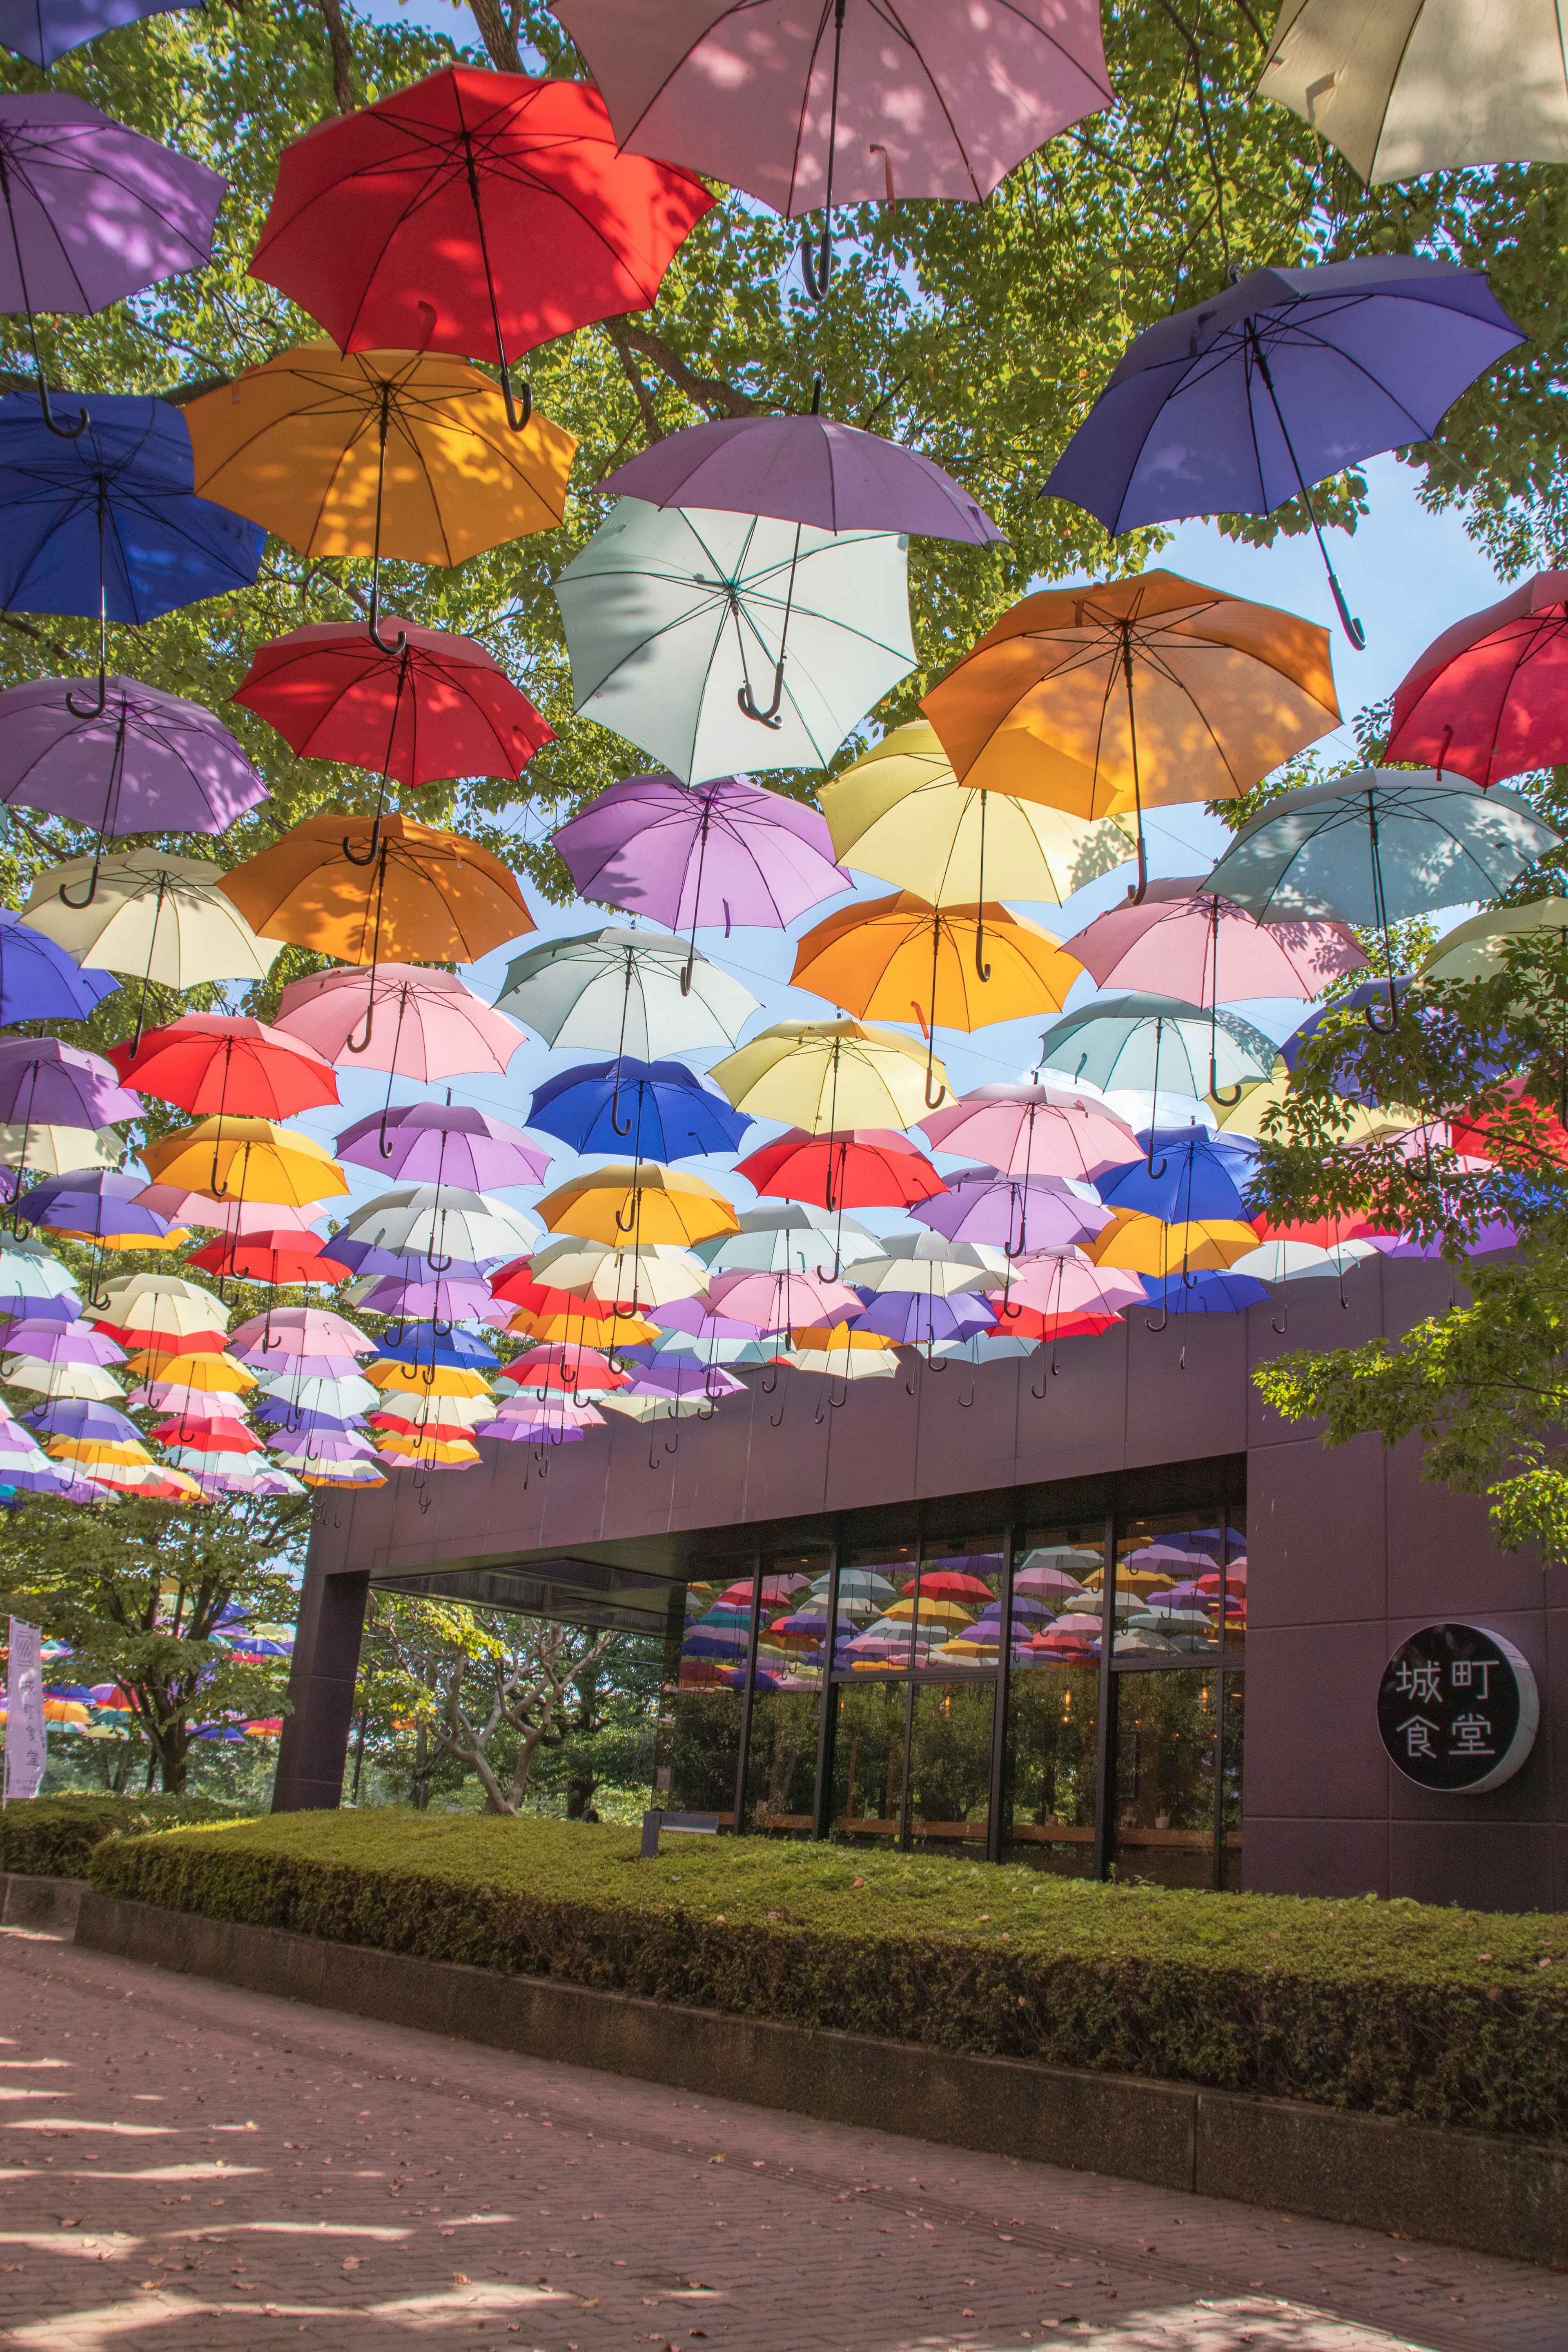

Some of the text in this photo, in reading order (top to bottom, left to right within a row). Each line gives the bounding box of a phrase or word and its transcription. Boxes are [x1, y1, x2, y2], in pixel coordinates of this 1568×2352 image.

[1396, 1660, 1500, 1704] 城町
[19, 1679, 40, 1766] 城町食堂
[1396, 1713, 1496, 1759] 食堂
